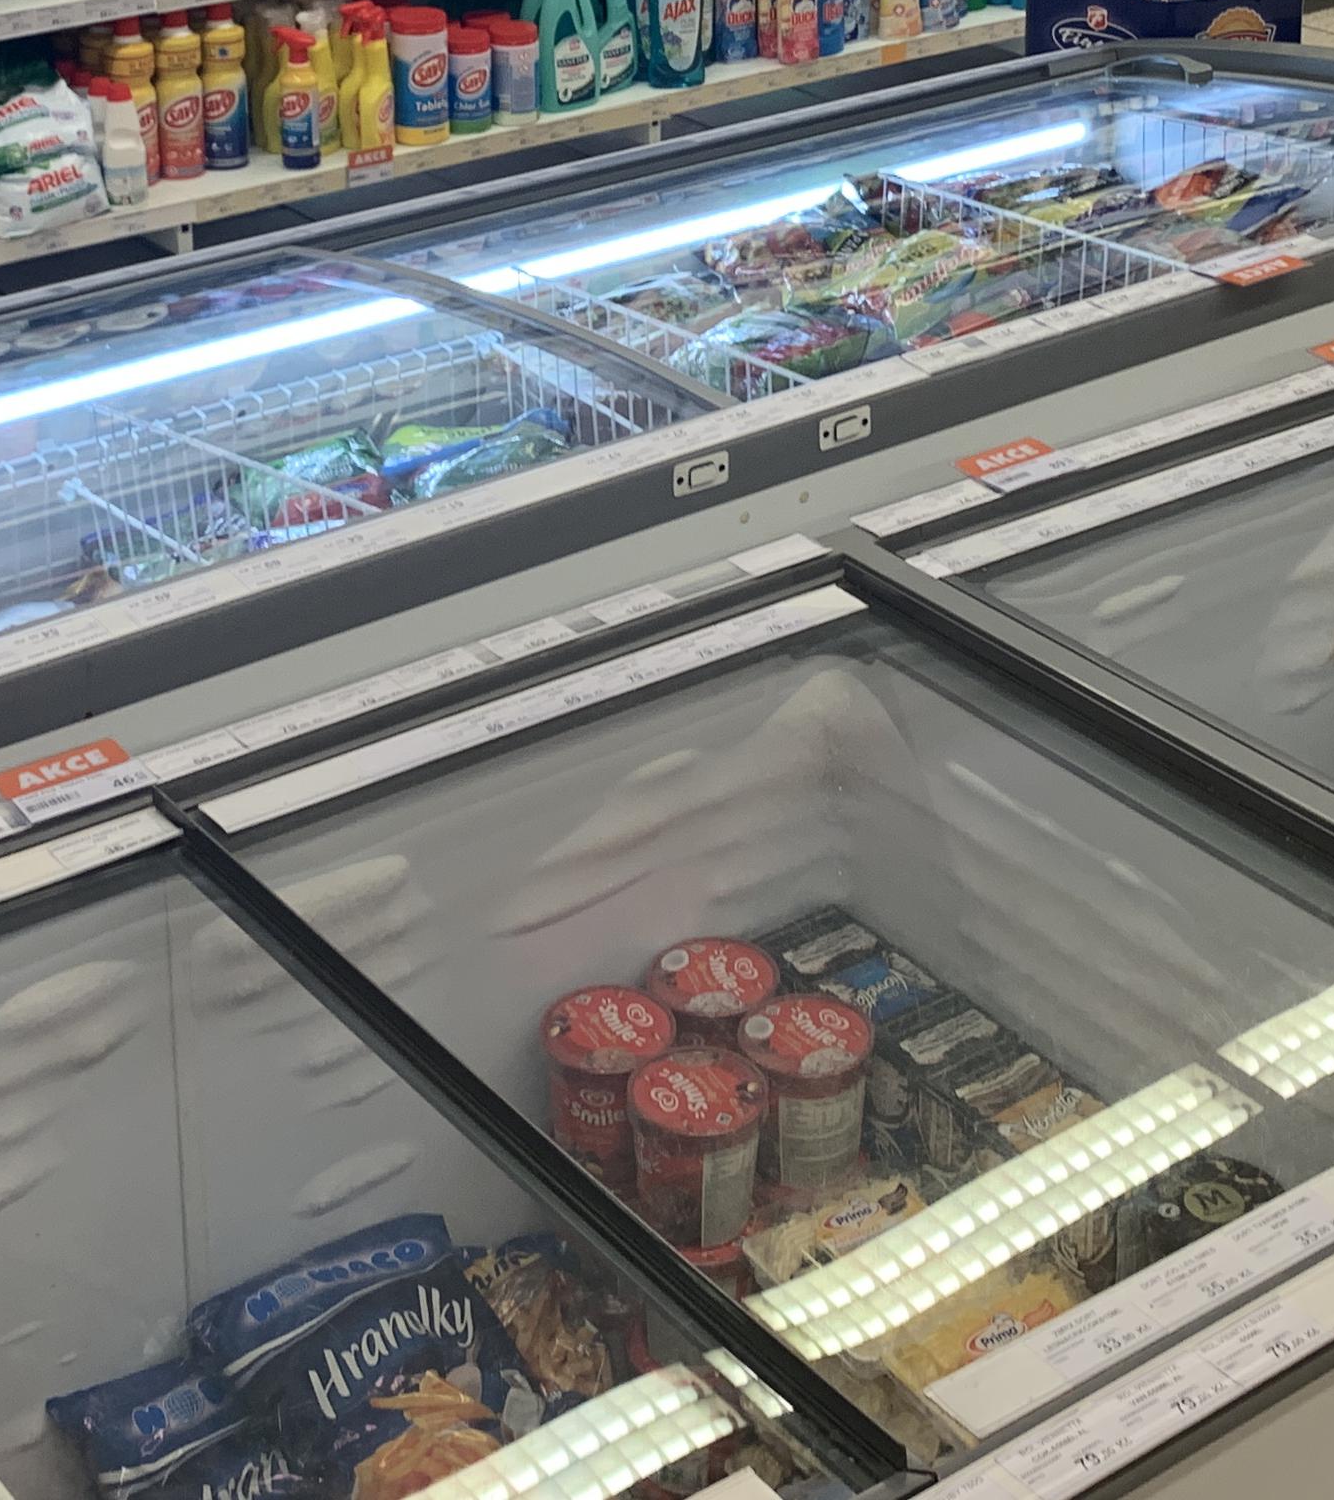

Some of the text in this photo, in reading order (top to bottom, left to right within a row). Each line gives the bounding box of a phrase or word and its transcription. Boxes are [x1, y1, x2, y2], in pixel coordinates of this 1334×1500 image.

[413, 58, 447, 82] SAVO
[165, 97, 198, 126] SAVO
[356, 150, 389, 165] AKCE
[28, 166, 81, 195] ARIEL
[976, 444, 1036, 471] AKCE
[19, 747, 109, 789] AKCE
[710, 952, 738, 991] Smile
[602, 1003, 637, 1041] Smile
[792, 1010, 837, 1045] Smile
[670, 1073, 710, 1113] Smile
[571, 1106, 625, 1126] Smile
[1198, 1187, 1233, 1211] M
[834, 1205, 873, 1228] Prima
[979, 1324, 1018, 1348] Prima
[308, 1284, 475, 1420] Hranolky
